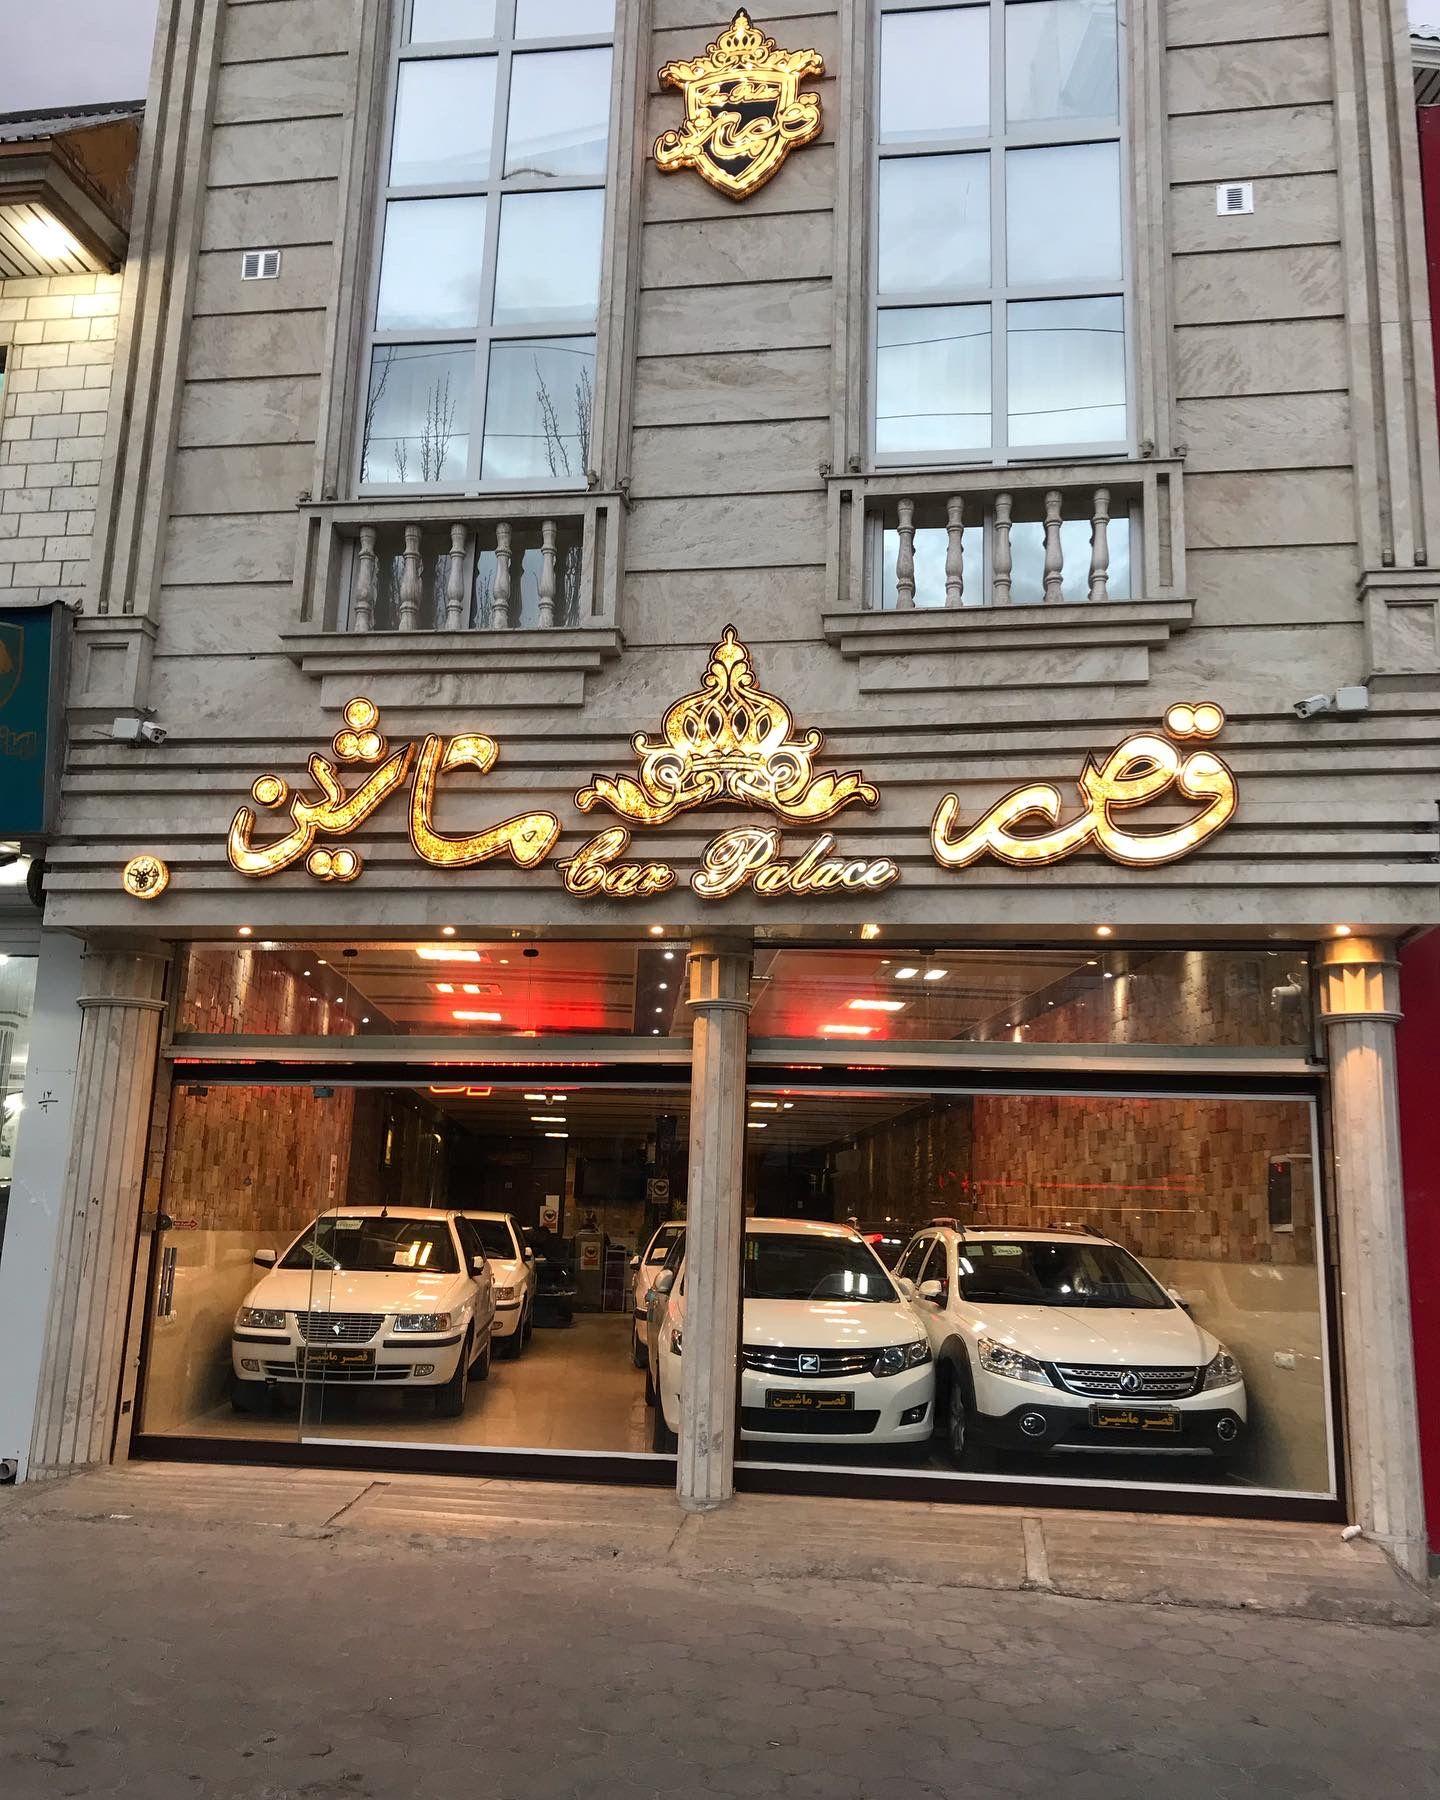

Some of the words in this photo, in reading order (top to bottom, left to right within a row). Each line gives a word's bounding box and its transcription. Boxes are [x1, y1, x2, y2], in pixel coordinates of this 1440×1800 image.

[227, 696, 563, 879] ماشین
[930, 700, 1240, 869] قصر
[552, 825, 679, 898] Car
[690, 825, 902, 899] Palace
[773, 1393, 813, 1408] ماشین
[815, 1393, 847, 1408] قصر
[1141, 1413, 1174, 1428] قصر
